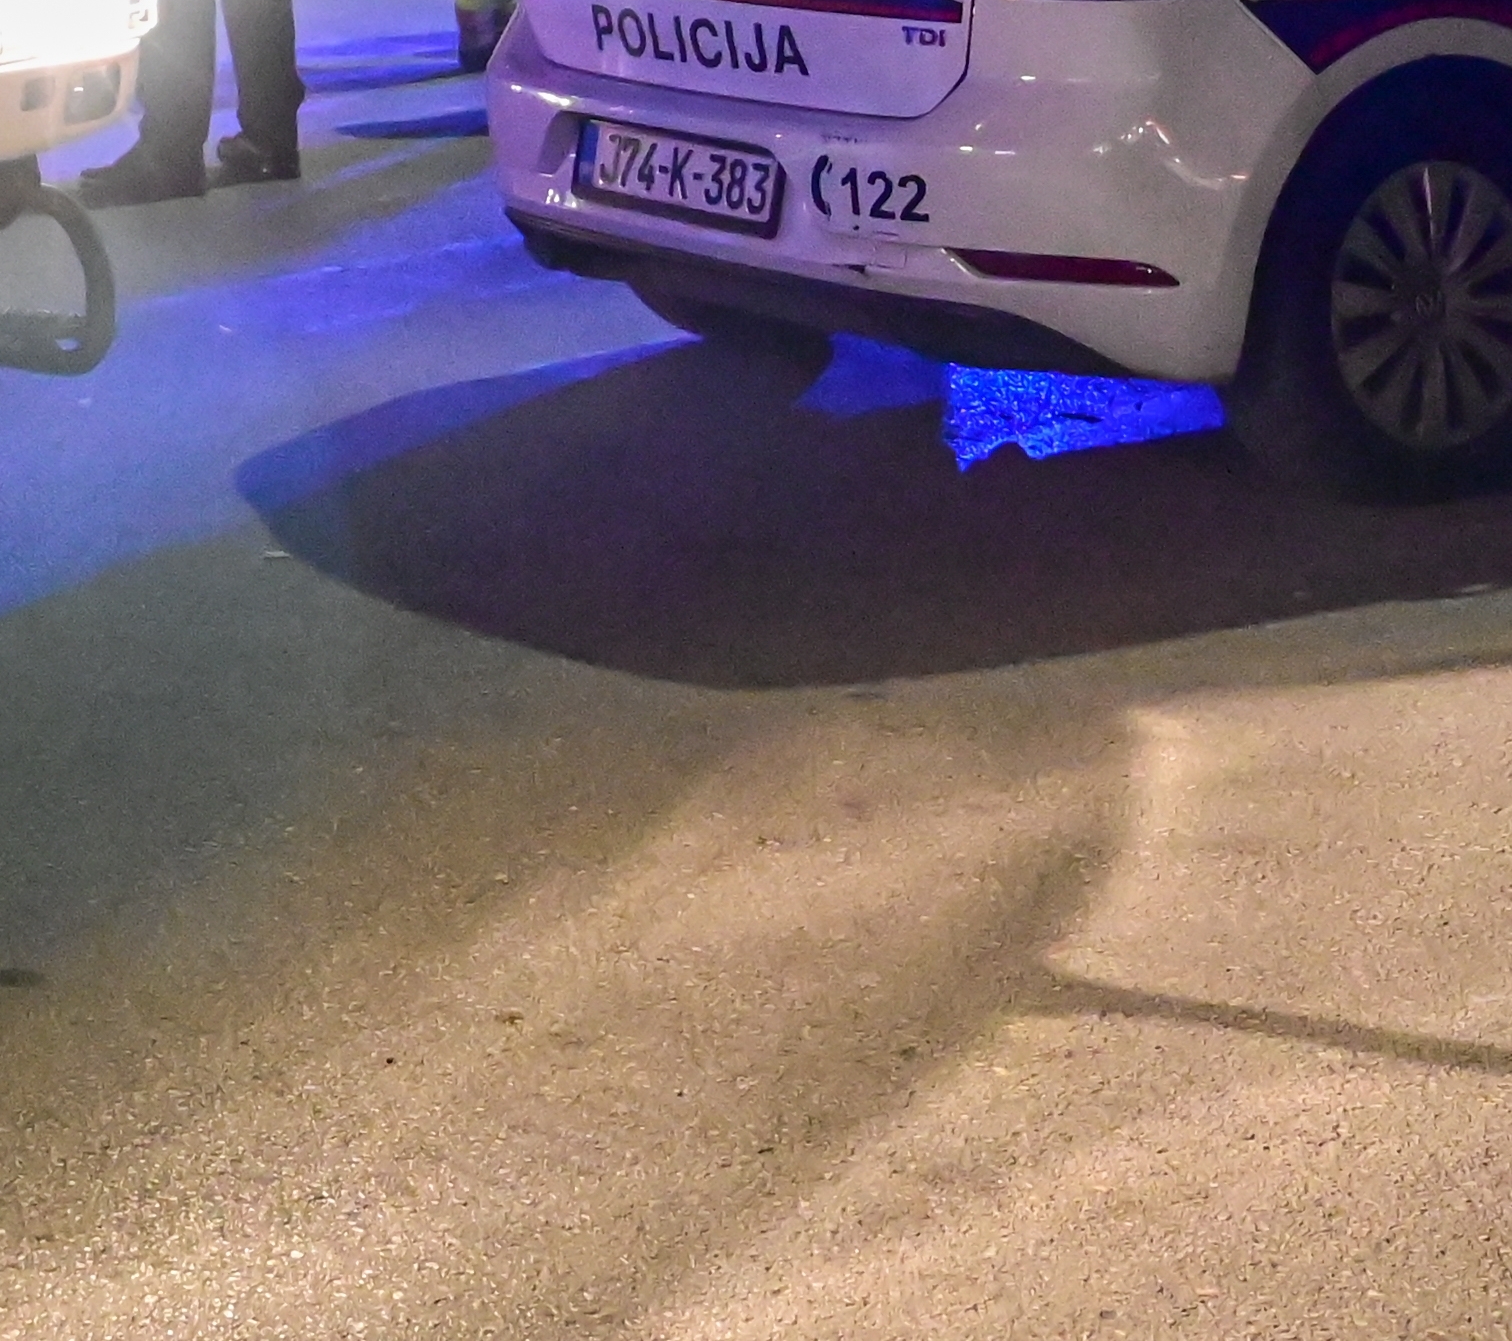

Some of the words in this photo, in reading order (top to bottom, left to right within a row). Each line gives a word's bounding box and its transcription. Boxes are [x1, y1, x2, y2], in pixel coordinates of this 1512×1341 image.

[591, 4, 810, 77] POLICIJA
[902, 24, 947, 48] TDI
[599, 133, 773, 216] J74-K-383
[840, 165, 930, 224] 122
